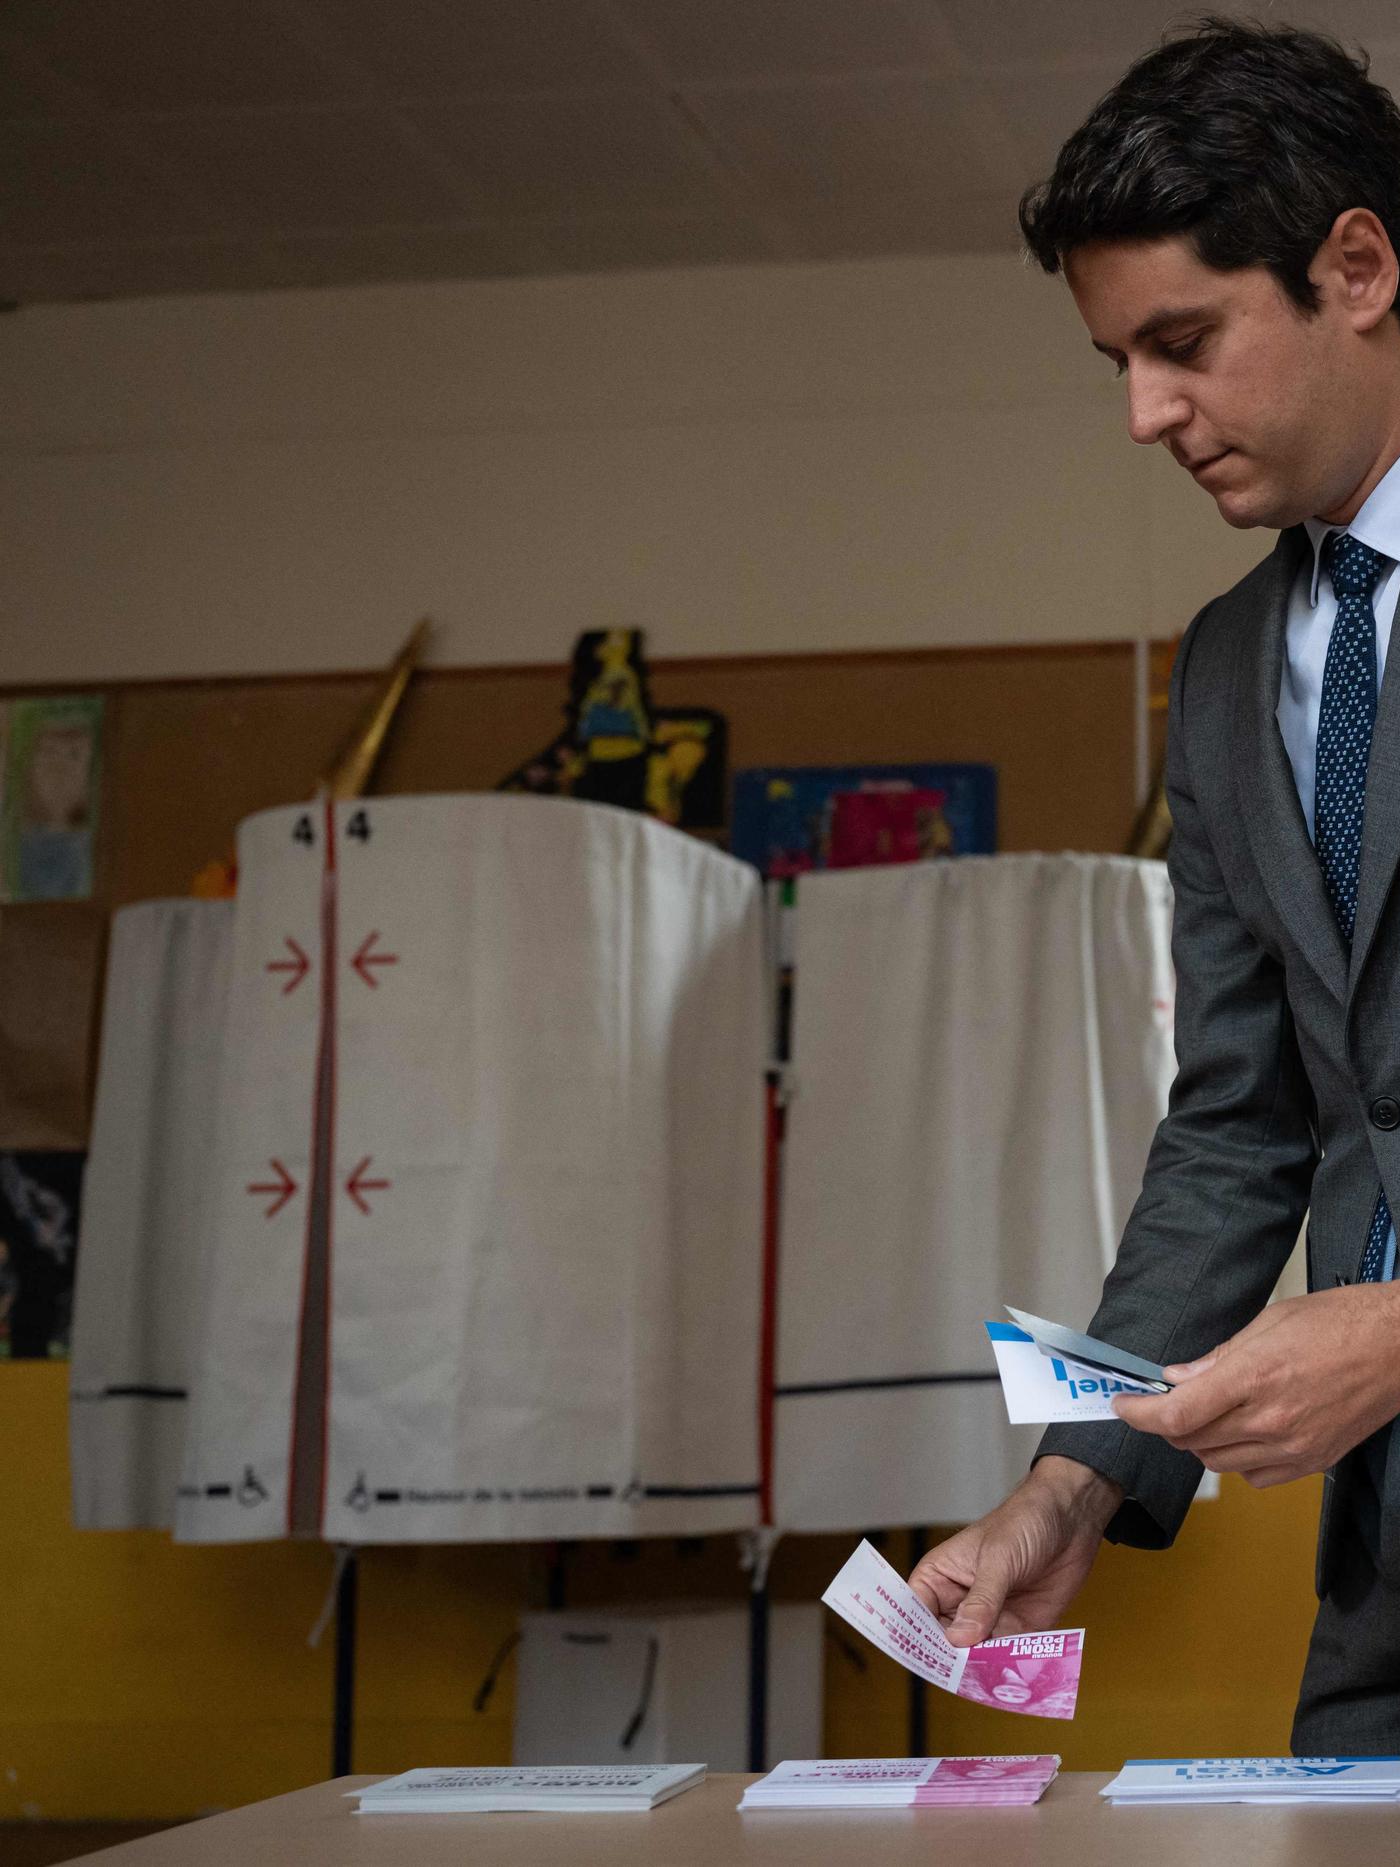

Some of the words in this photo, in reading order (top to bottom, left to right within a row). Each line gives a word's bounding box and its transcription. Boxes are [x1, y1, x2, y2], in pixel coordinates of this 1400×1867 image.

[293, 813, 314, 847] 4
[345, 810, 371, 843] 4
[876, 1584, 922, 1633] PERONI
[1009, 1643, 1064, 1656] FRONT
[1175, 1765, 1356, 1776] Attal
